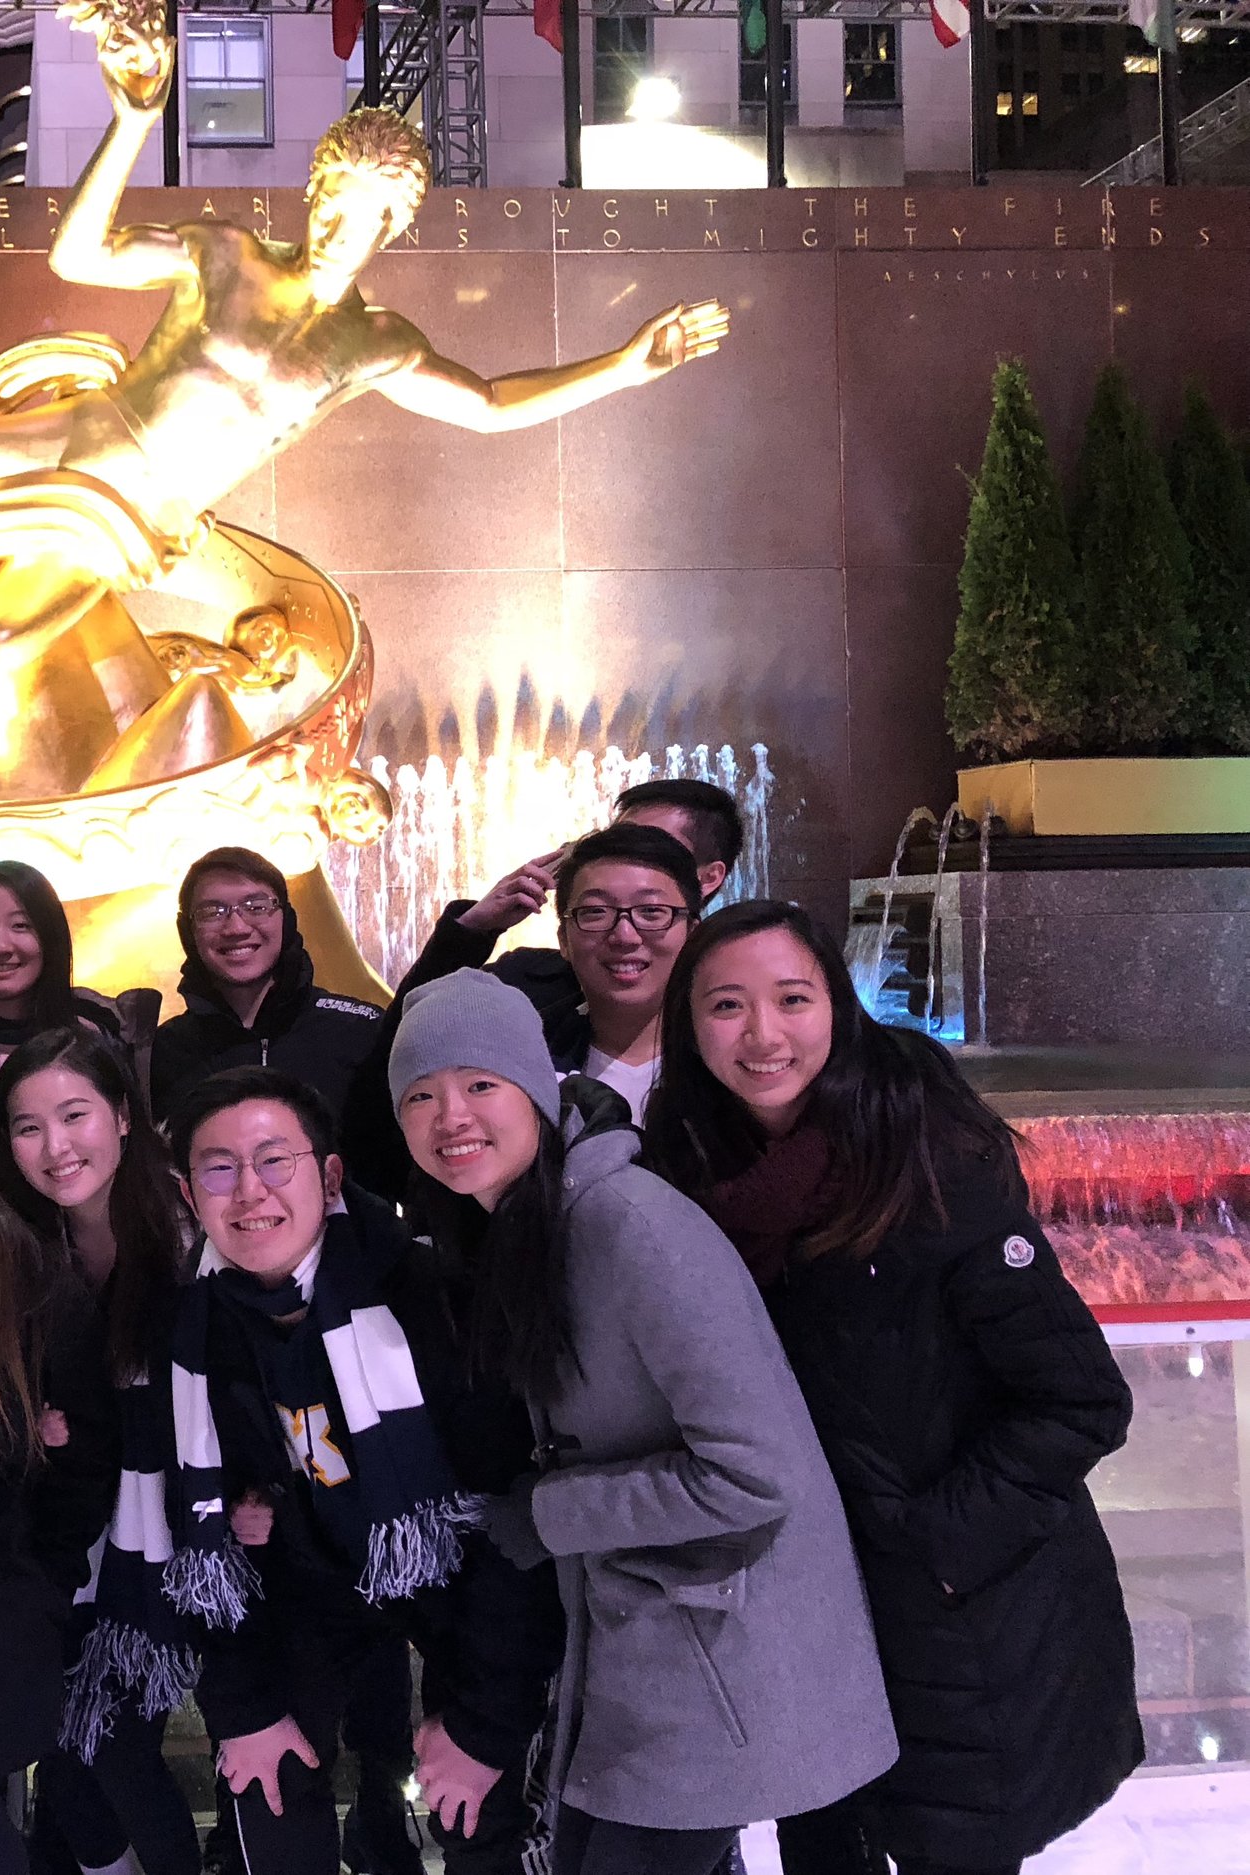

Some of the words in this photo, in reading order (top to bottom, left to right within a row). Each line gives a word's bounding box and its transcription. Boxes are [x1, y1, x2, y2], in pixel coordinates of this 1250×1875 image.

[455, 198, 718, 218] ROUGHT
[803, 198, 917, 218] THE
[1004, 197, 1163, 218] FIRE
[556, 228, 621, 248] TO
[703, 226, 968, 249] MIGHTY
[1054, 226, 1211, 247] ENDS
